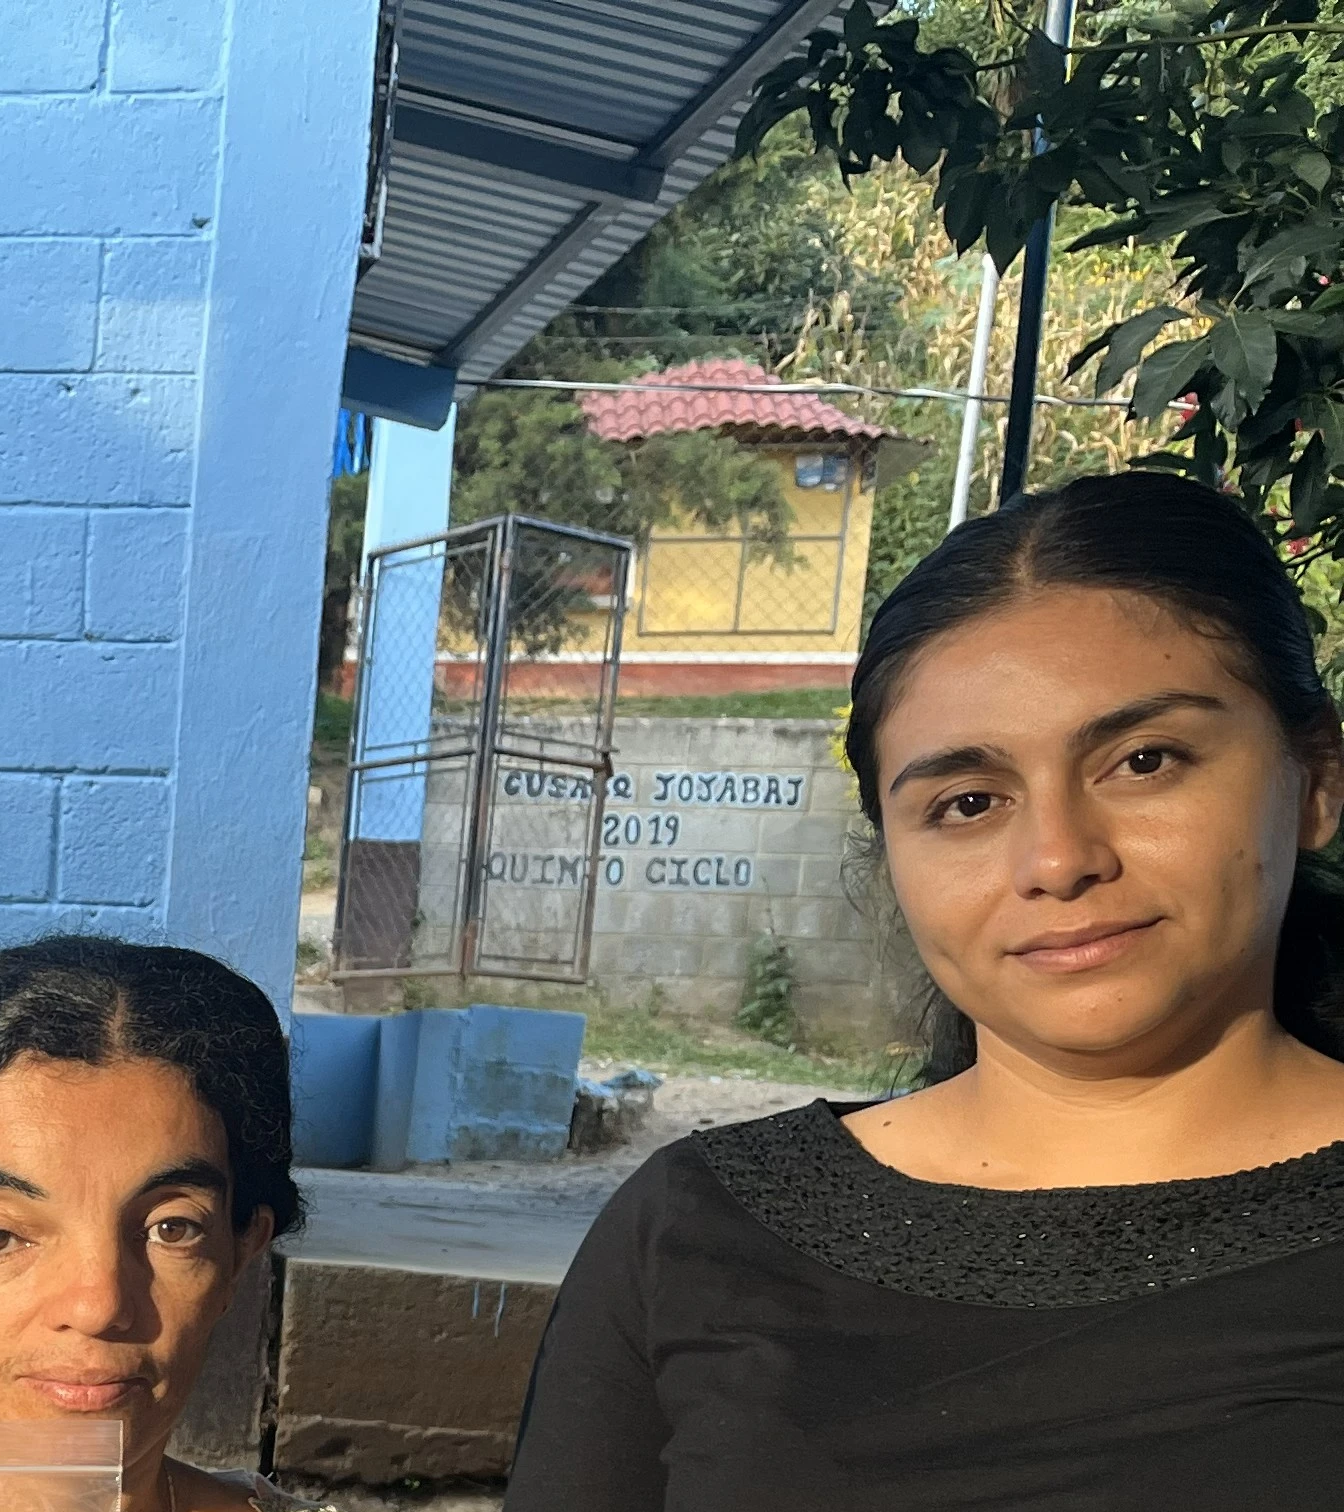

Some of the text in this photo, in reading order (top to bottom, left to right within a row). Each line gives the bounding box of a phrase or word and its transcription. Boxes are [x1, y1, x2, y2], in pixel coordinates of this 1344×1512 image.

[653, 773, 804, 806] JOJABAJ
[603, 813, 680, 847] 2019
[645, 856, 752, 887] CICLO
